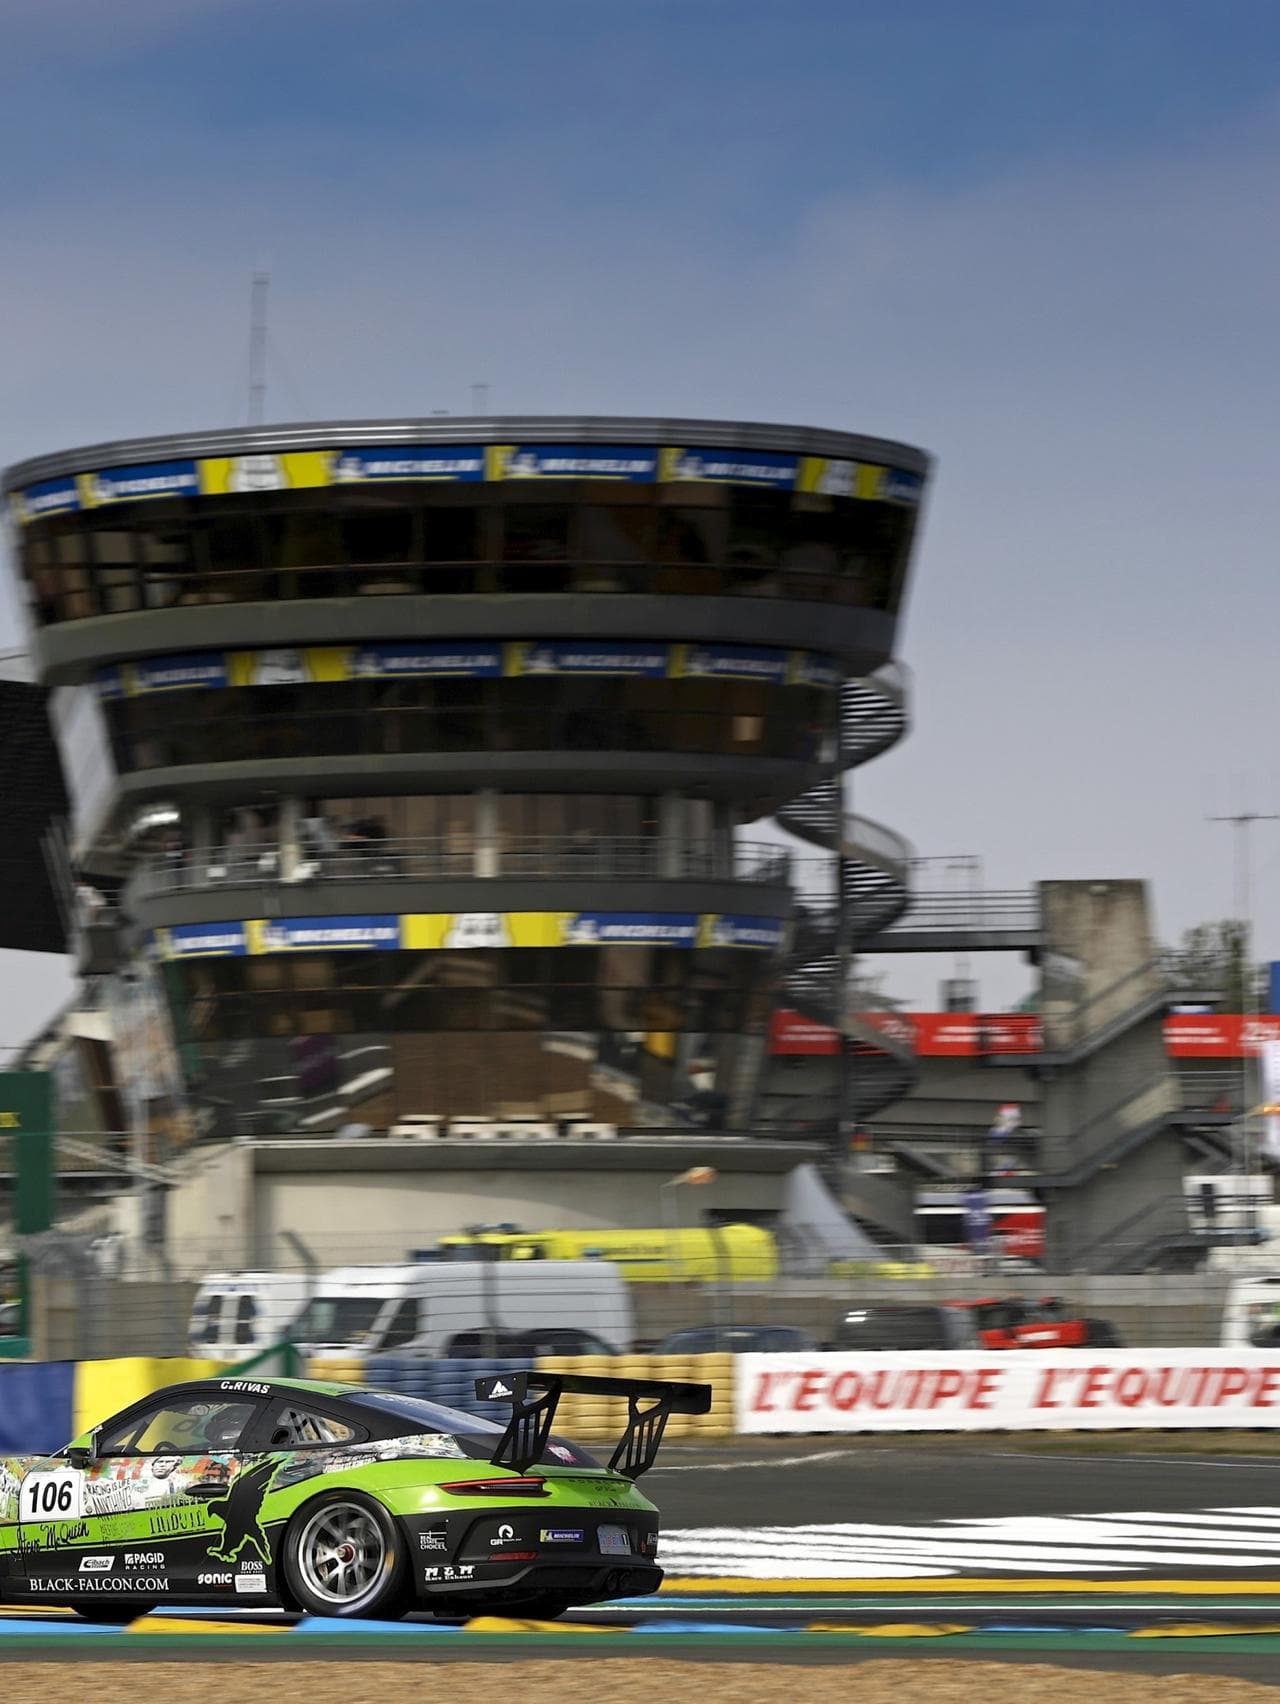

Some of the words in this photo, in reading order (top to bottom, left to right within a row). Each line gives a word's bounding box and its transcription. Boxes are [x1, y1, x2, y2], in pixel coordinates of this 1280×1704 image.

[221, 1380, 271, 1394] C.RIVAS
[28, 1480, 74, 1514] 106
[134, 1553, 165, 1564] PAGID
[241, 1560, 263, 1571] BOSS
[29, 1577, 170, 1592] BLACK-FALCON.COM
